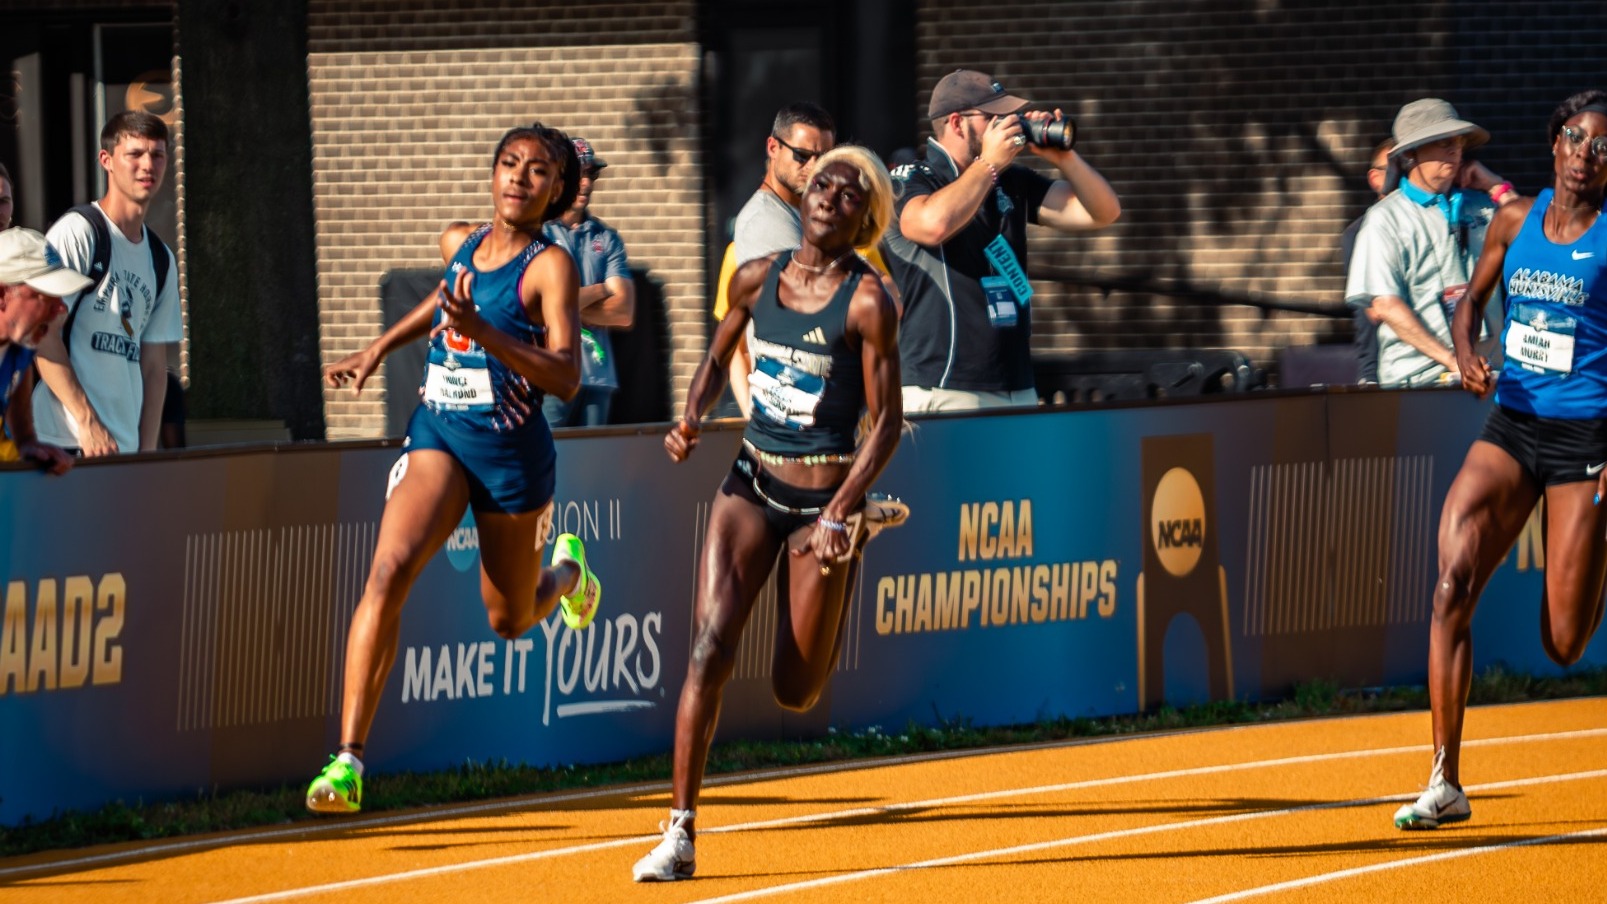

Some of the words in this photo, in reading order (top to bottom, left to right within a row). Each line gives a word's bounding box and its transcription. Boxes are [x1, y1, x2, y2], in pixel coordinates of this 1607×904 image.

[987, 240, 1028, 297] CONTENT
[1511, 267, 1584, 294] ALABAMA
[958, 498, 1033, 562] NCAA
[1158, 517, 1202, 550] NCAA
[874, 558, 1118, 636] CHAMPIONSHIPS
[401, 640, 496, 704] MAKE
[503, 638, 534, 695] IT
